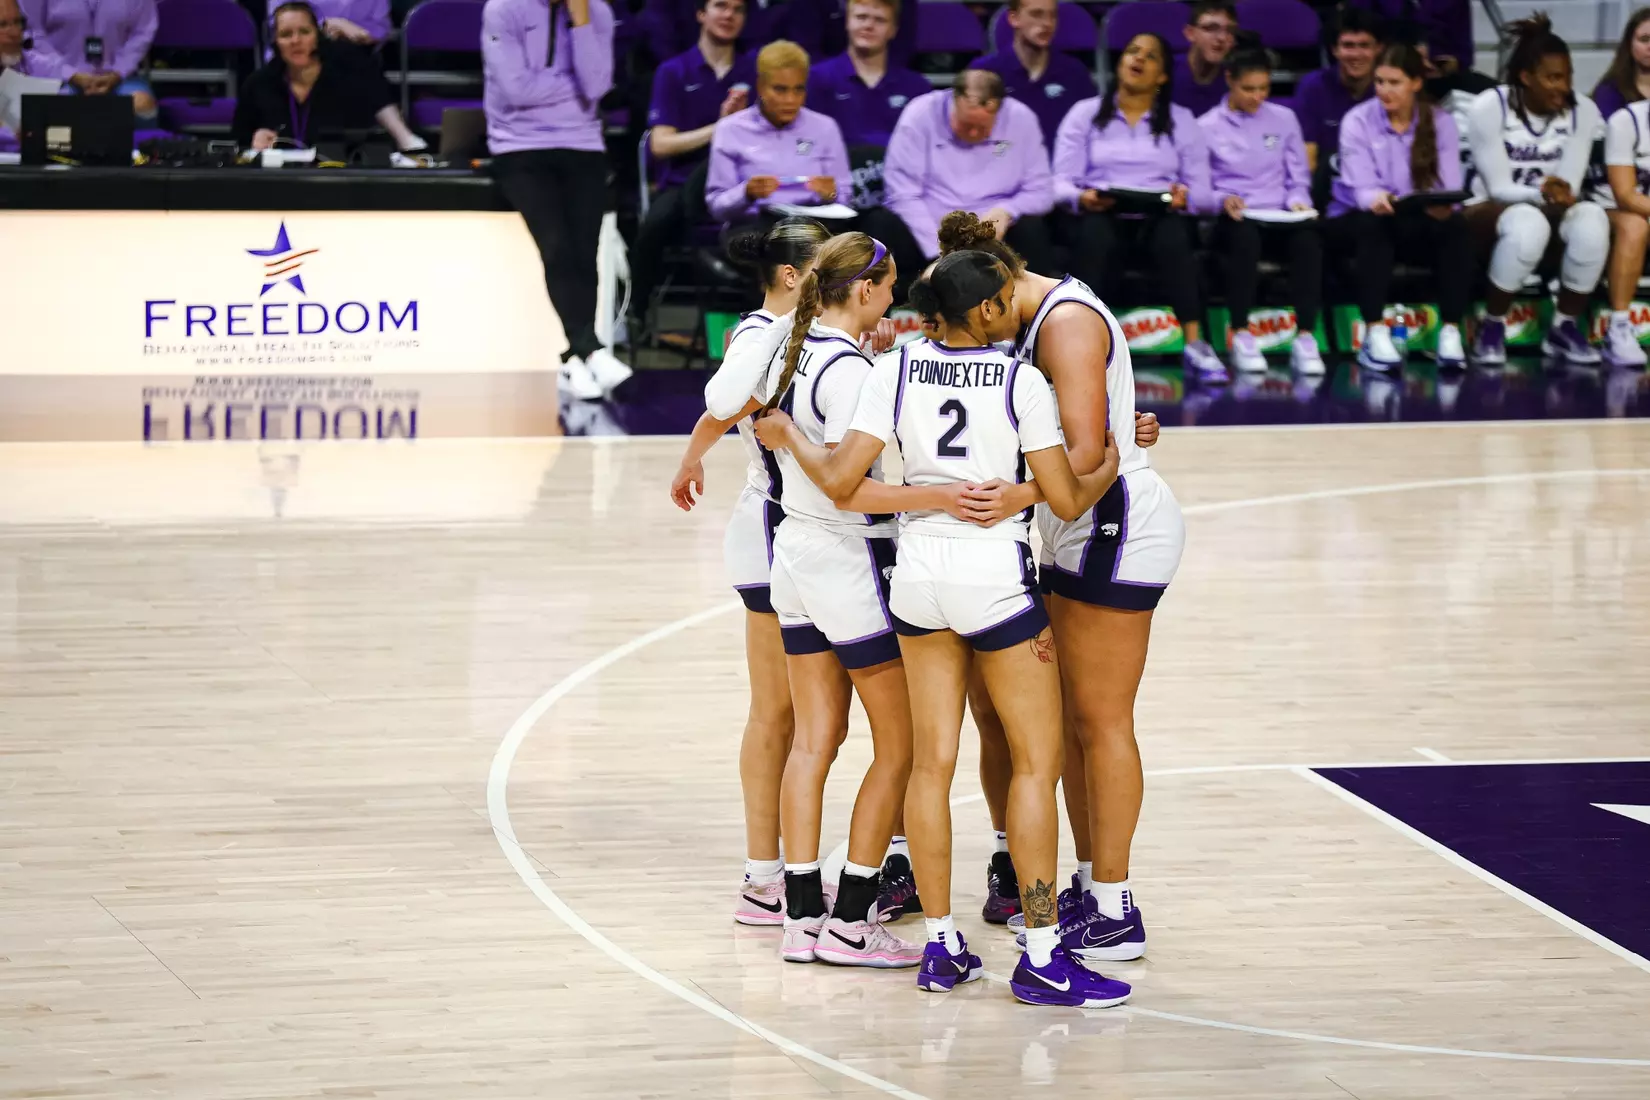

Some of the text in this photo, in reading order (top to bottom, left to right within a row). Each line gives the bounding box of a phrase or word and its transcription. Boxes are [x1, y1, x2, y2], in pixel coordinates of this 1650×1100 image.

[144, 299, 419, 338] FREEDOM
[908, 358, 1005, 388] POINDEXTER
[937, 398, 969, 459] 2
